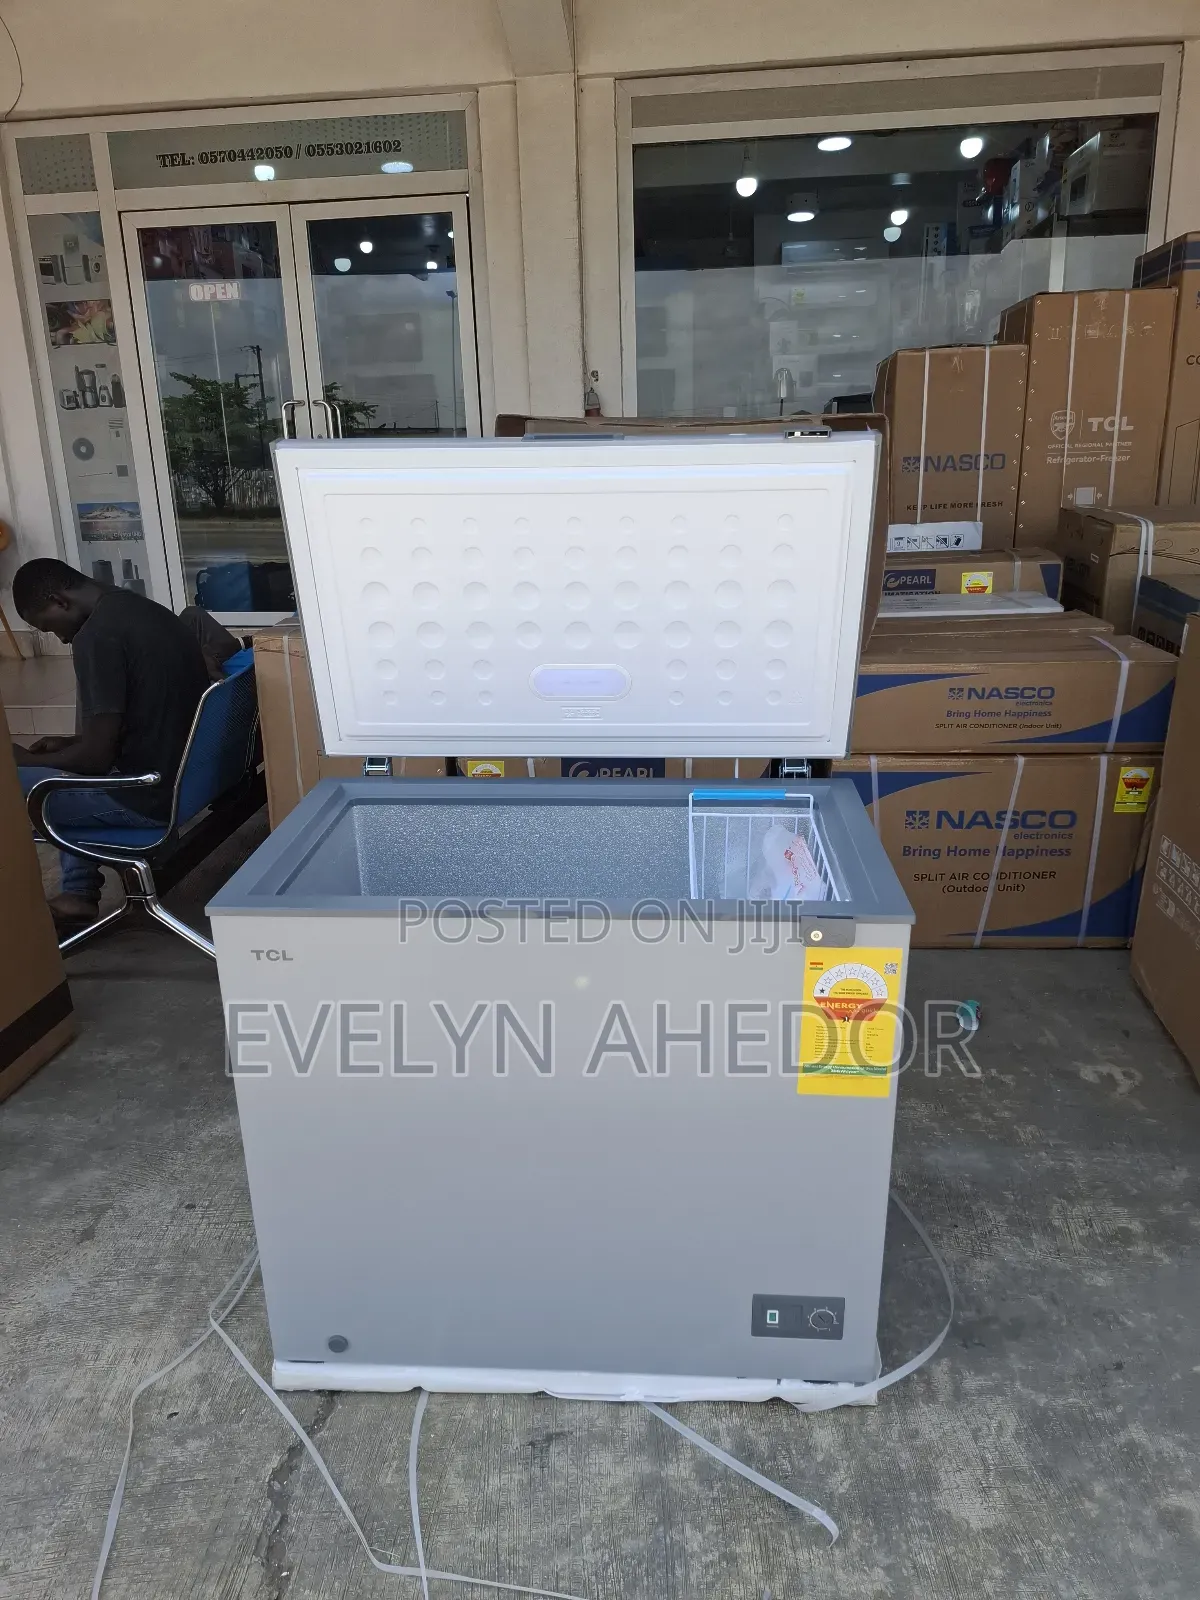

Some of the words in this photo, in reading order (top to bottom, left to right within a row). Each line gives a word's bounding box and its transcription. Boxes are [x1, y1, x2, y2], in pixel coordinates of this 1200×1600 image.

[156, 152, 195, 168] TEL:
[198, 145, 293, 165] 0570442050
[304, 140, 402, 158] 0553021602
[190, 282, 239, 300] OPEN
[1087, 414, 1134, 432] TCL
[924, 453, 1006, 473] NASCO
[1046, 454, 1131, 466] Refrgerator-Frezer
[906, 503, 928, 511] KEP
[930, 502, 948, 510] LIFE
[900, 575, 932, 585] PEARL
[967, 686, 1056, 700] NASCO
[946, 710, 971, 719] Bring
[973, 709, 1002, 718] Home
[1004, 708, 1052, 719] Happiness
[935, 810, 1078, 830] NASCO
[1013, 831, 1074, 840] electronics
[902, 845, 942, 860] Bring
[946, 845, 991, 857] Home
[913, 873, 946, 882] SPLIT
[949, 872, 969, 881] AIR
[941, 884, 992, 894] (Outdoo
[997, 883, 1026, 893] Unit)
[250, 949, 294, 961] TCL
